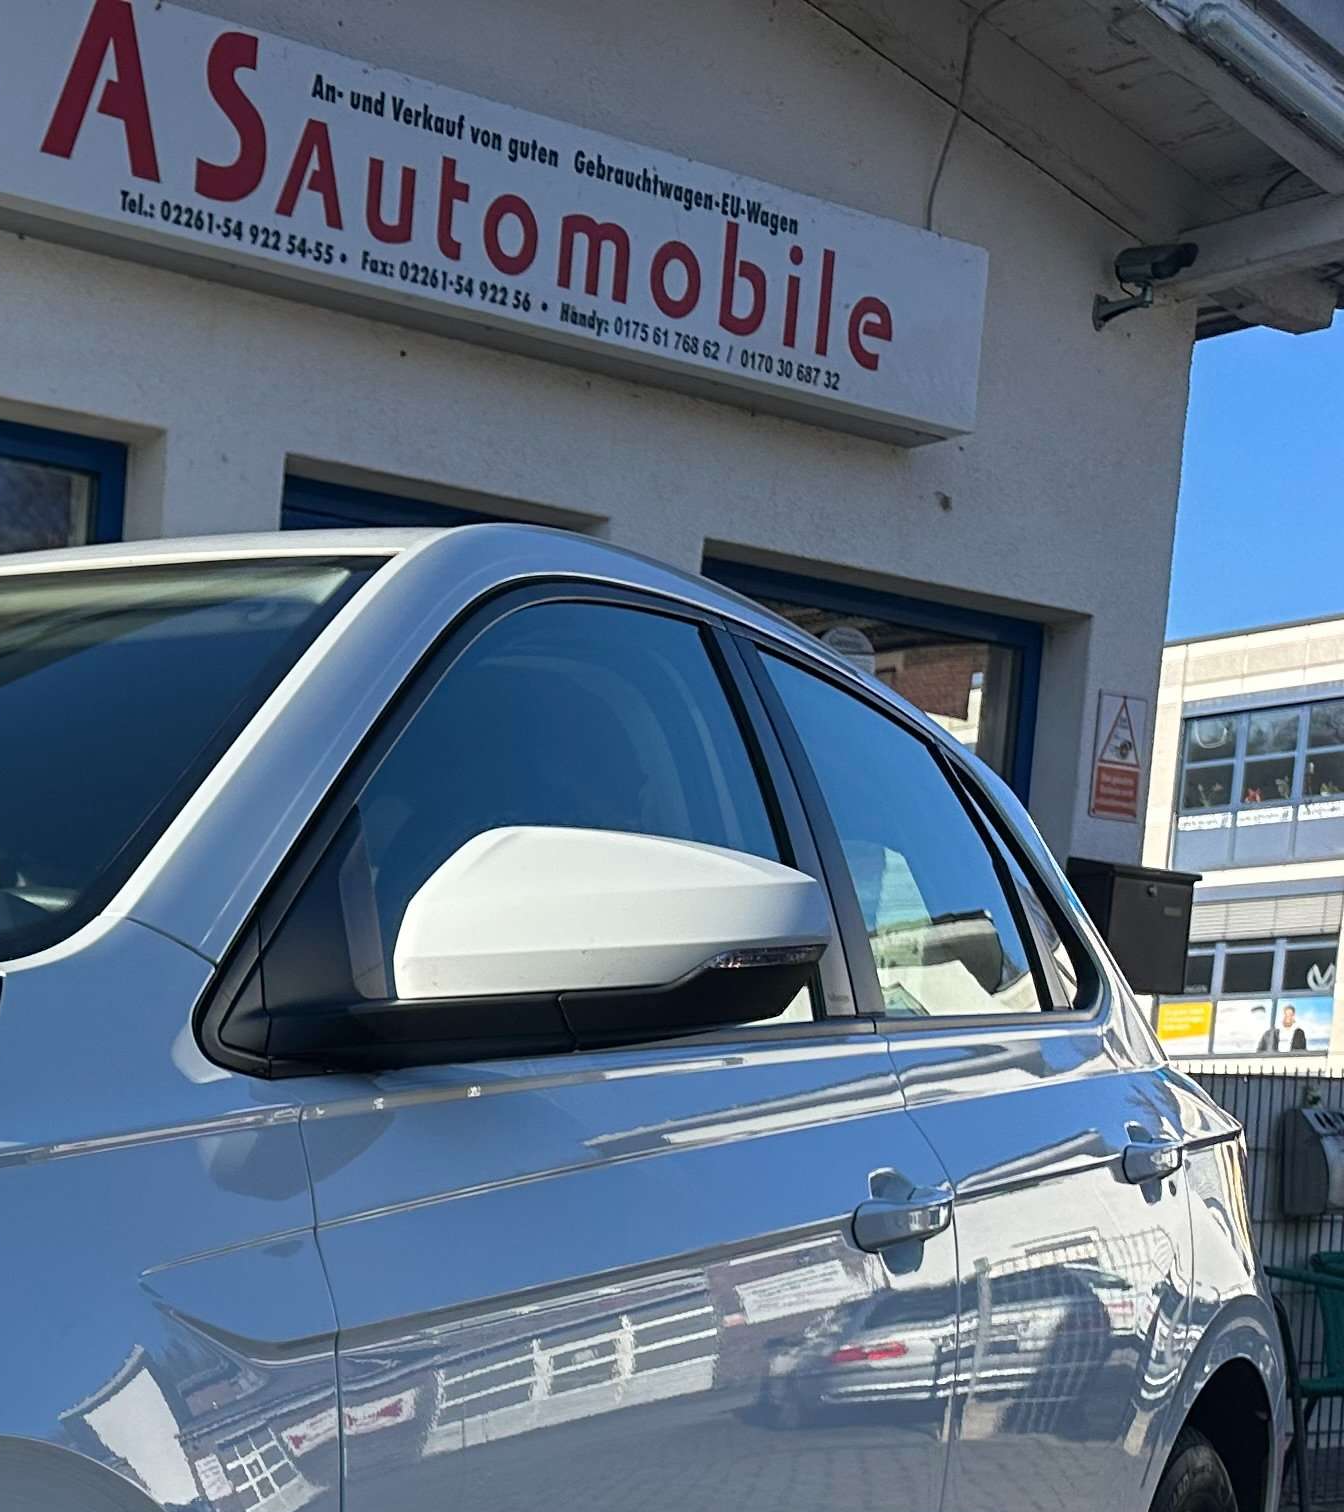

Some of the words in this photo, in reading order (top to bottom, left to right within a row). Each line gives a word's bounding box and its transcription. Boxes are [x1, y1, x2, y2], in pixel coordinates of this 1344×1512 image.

[311, 74, 344, 104] An-
[350, 91, 385, 118] und
[391, 95, 466, 141] Verkauf
[470, 123, 503, 152] von
[507, 135, 560, 169] guten
[120, 189, 155, 219] Tel.:
[160, 200, 243, 242] 02261-54
[249, 224, 282, 252] 922
[286, 233, 335, 265] 54-55
[361, 250, 395, 277] Fax:
[399, 260, 474, 299] 02261-54
[479, 281, 509, 307] 922
[512, 290, 532, 313] 56
[613, 315, 650, 342] 0175
[652, 325, 670, 349] 61
[674, 331, 700, 355] 768
[701, 338, 721, 361] 62
[740, 349, 774, 375] 0170
[776, 358, 793, 379] 30
[796, 363, 821, 388] 687
[823, 370, 841, 392] 32
[274, 117, 894, 372] Automobile
